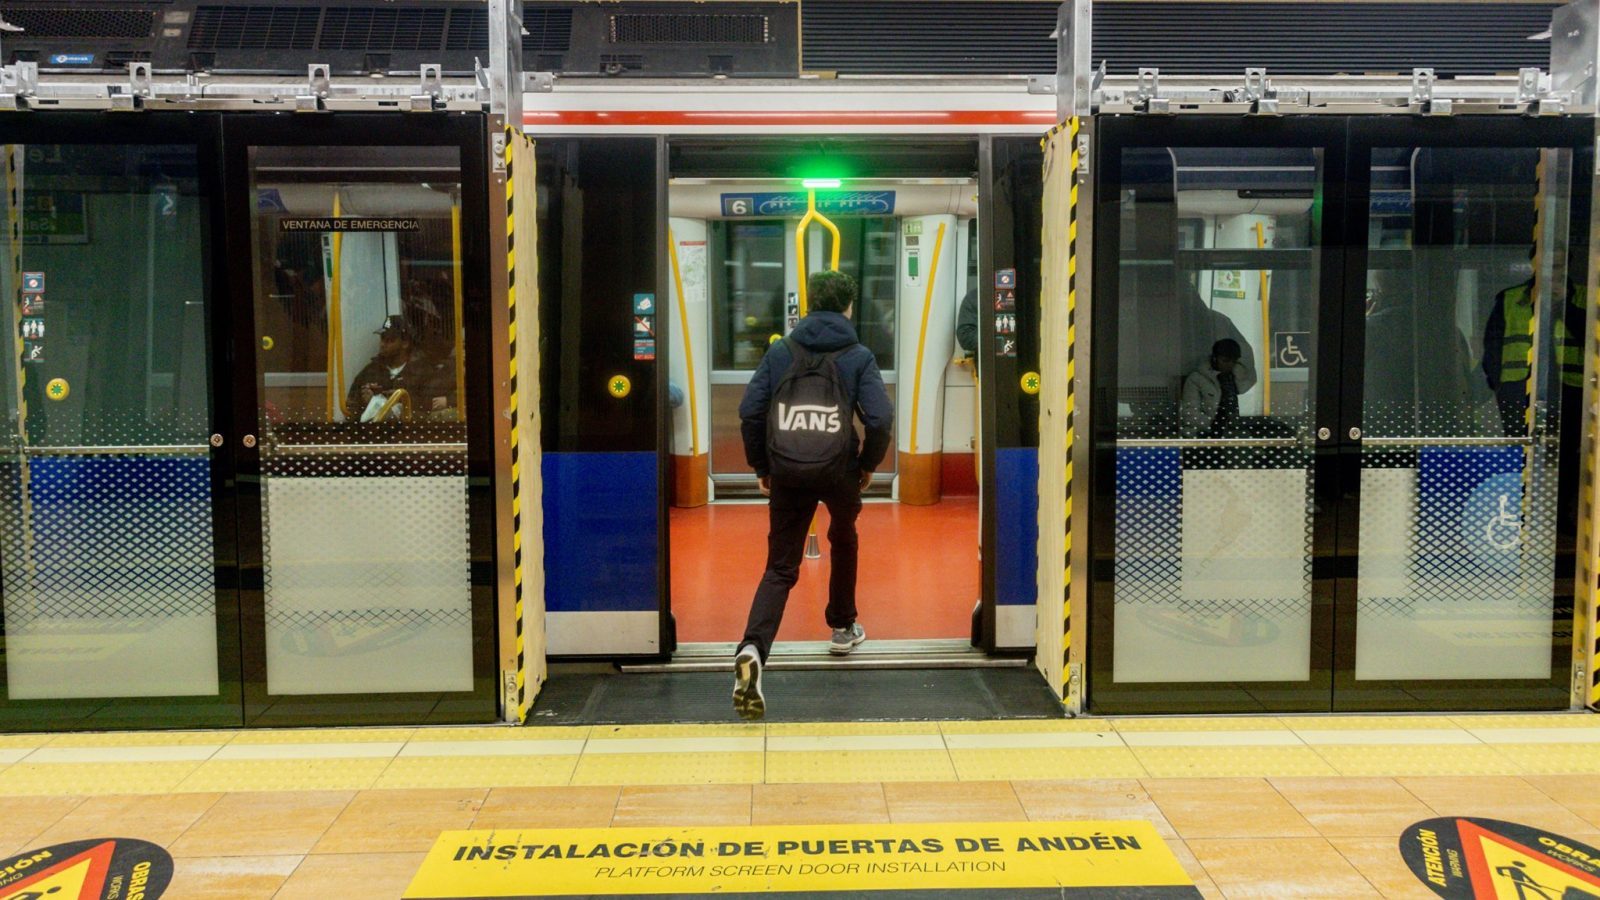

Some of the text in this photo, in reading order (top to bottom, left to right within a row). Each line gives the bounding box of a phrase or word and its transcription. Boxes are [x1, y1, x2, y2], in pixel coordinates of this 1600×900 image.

[732, 200, 747, 215] 6
[282, 220, 419, 230] VENTANA DE EMERGENCIA
[778, 402, 841, 433] VANS
[453, 832, 1142, 862] INSTALACIÓN DE PUERTAS DE ANDÉN
[1416, 828, 1447, 887] ATENCIÓN
[594, 861, 1006, 878] PLATFORM SCREEN DOOR INSTALLATION
